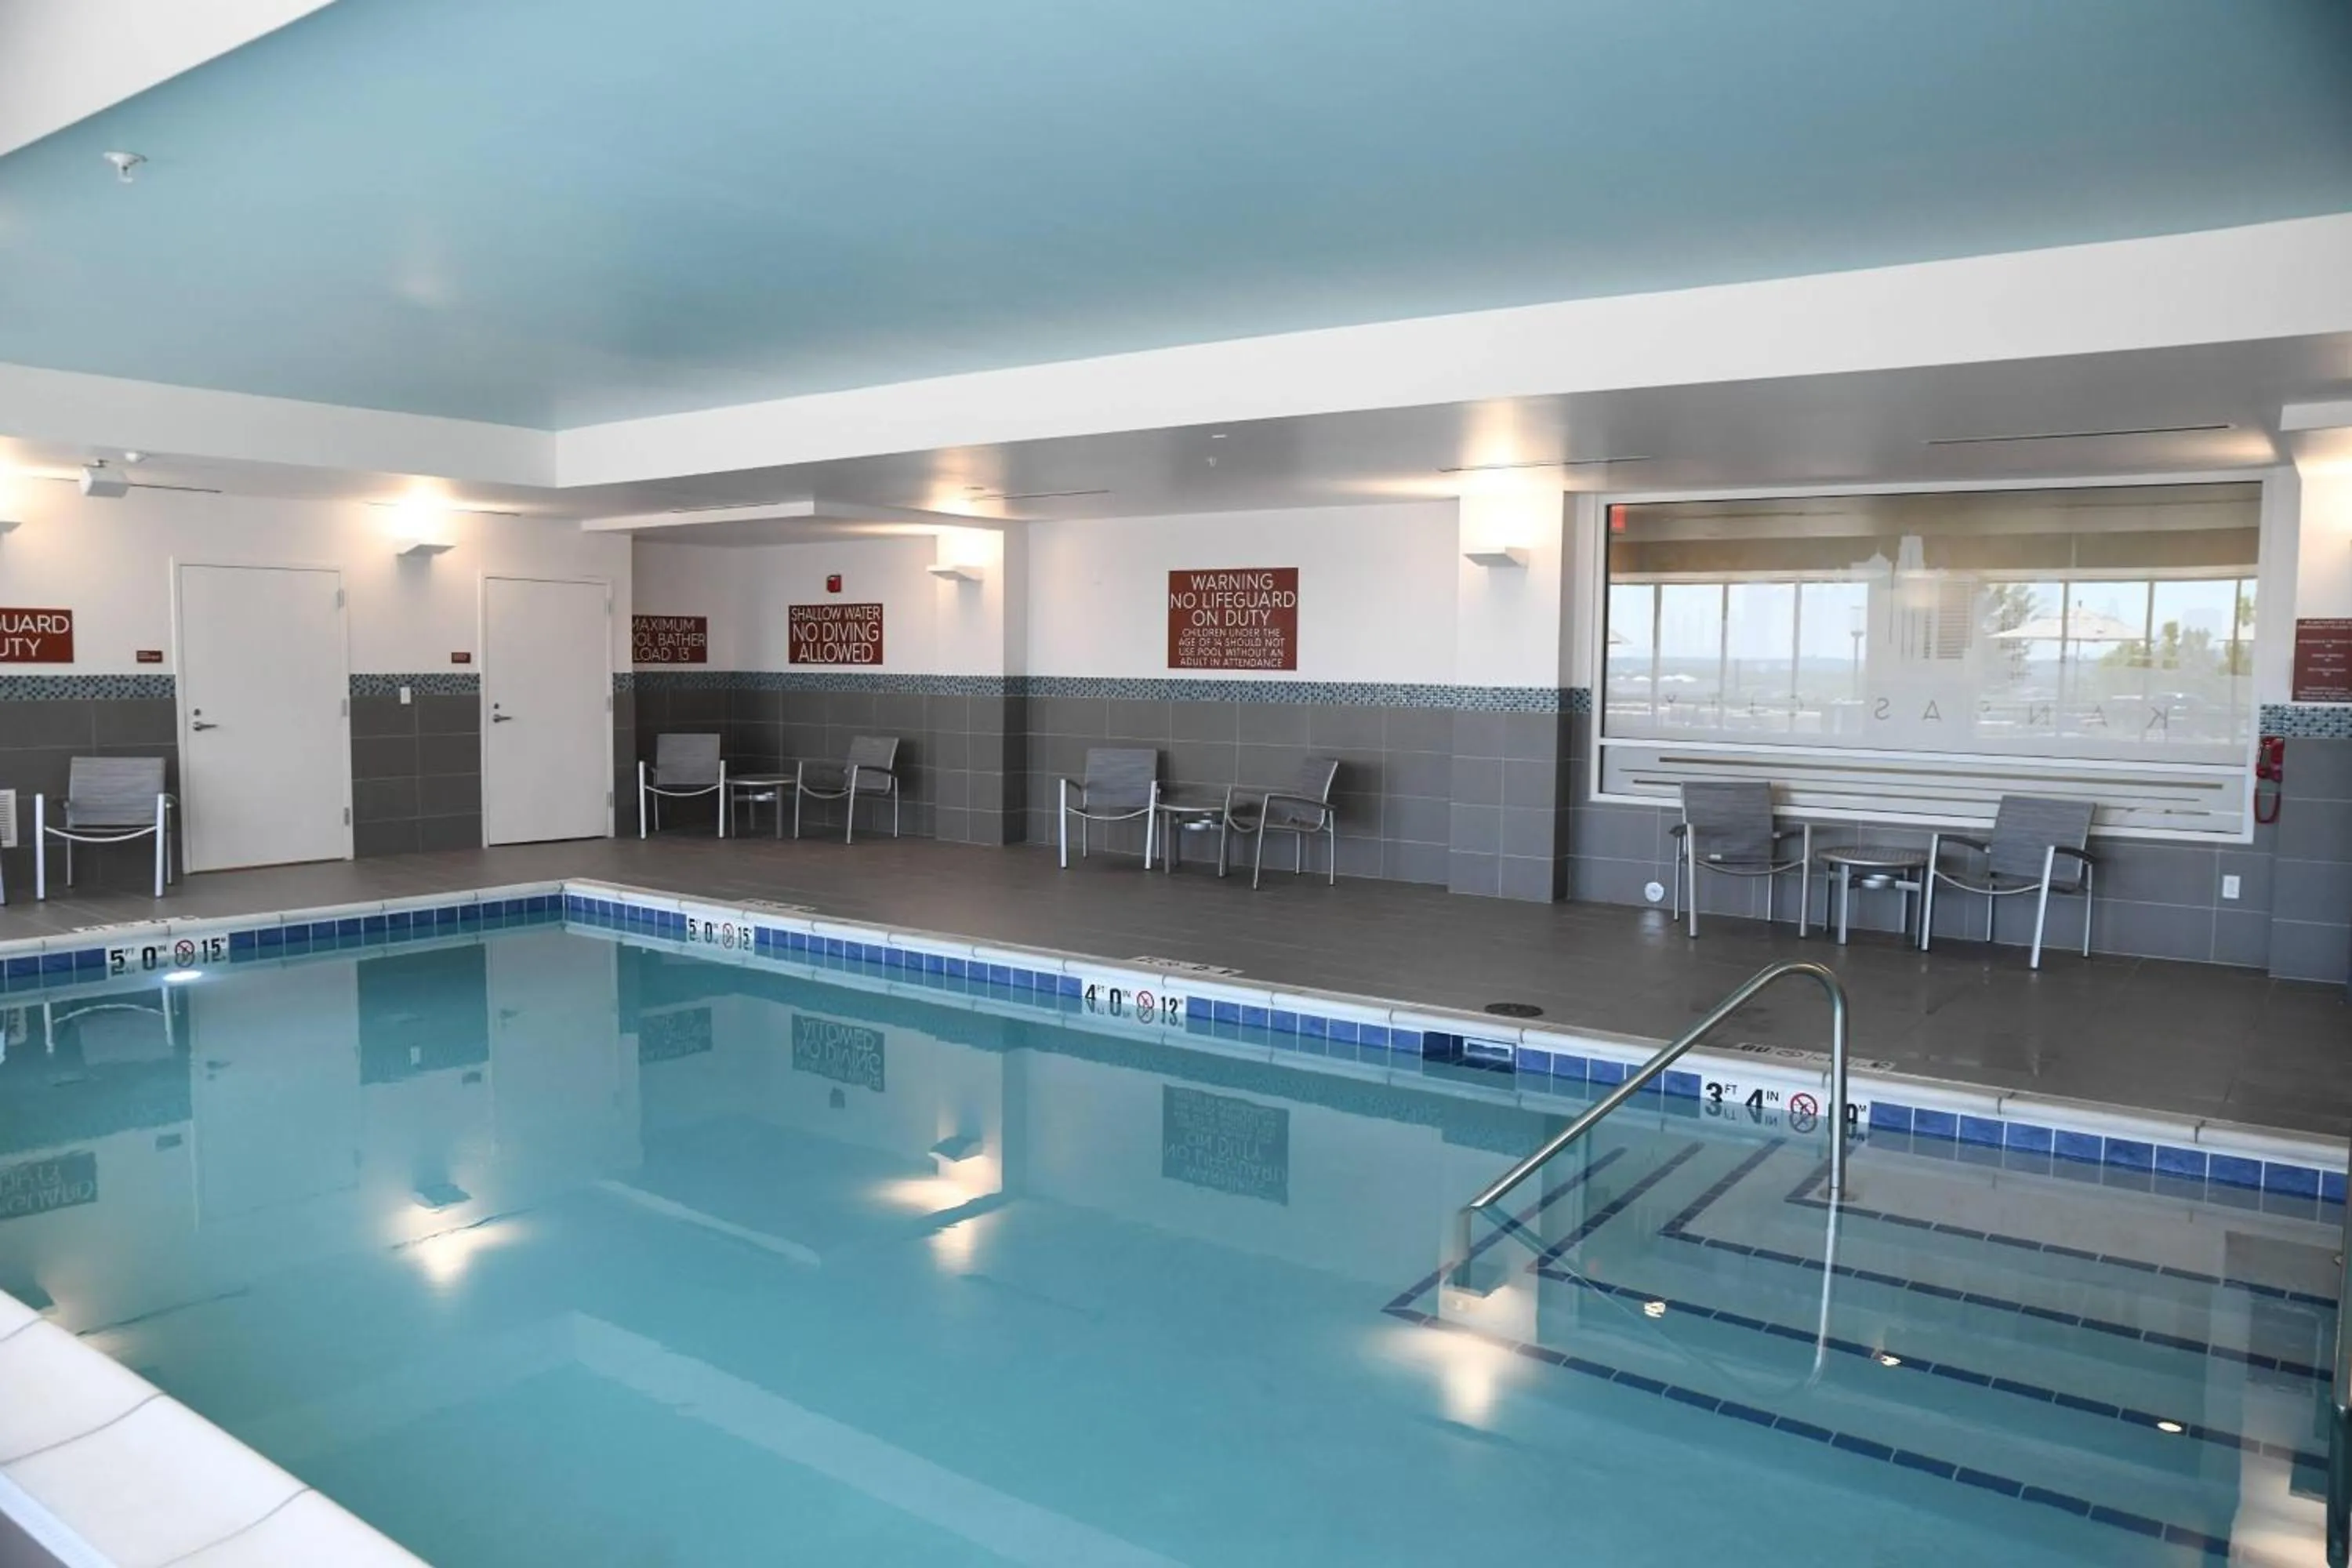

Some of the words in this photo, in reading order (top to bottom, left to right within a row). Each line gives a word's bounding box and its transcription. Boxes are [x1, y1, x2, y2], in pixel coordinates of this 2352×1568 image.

[1190, 573, 1274, 590] WARNING
[1171, 592, 1196, 609] NO
[1202, 590, 1296, 609] LIFEGUARD
[791, 606, 841, 622] SHALLOW
[844, 605, 880, 621] WATER
[1191, 609, 1218, 626] ON
[1225, 609, 1271, 626] DUTY
[0, 614, 70, 633] UARD
[793, 622, 818, 642] NO
[822, 622, 879, 642] DIVING
[658, 633, 706, 647] BATHER
[1181, 628, 1226, 637] CHILDREN
[1229, 628, 1260, 637] UNDER
[1263, 628, 1280, 637] THE
[1178, 637, 1196, 646] AGE
[1199, 637, 1211, 646] OF
[1225, 637, 1261, 647] SHOULD
[1264, 637, 1286, 647] NOT
[634, 647, 672, 661] LOAD
[798, 642, 874, 662] ALLOWED
[1178, 648, 1195, 656] USE
[1197, 648, 1222, 657] POOL
[1225, 648, 1267, 657] WITHOUT
[1270, 648, 1283, 657] AN
[1180, 657, 1208, 666] ADULT
[1210, 658, 1221, 666] IN
[1222, 658, 1283, 667] ATTENDANCE
[1085, 984, 1095, 1000] 4
[1705, 1082, 1723, 1102] 3
[1725, 1084, 1737, 1094] FT
[1744, 1088, 1763, 1109] 4
[1766, 1091, 1779, 1102] IN
